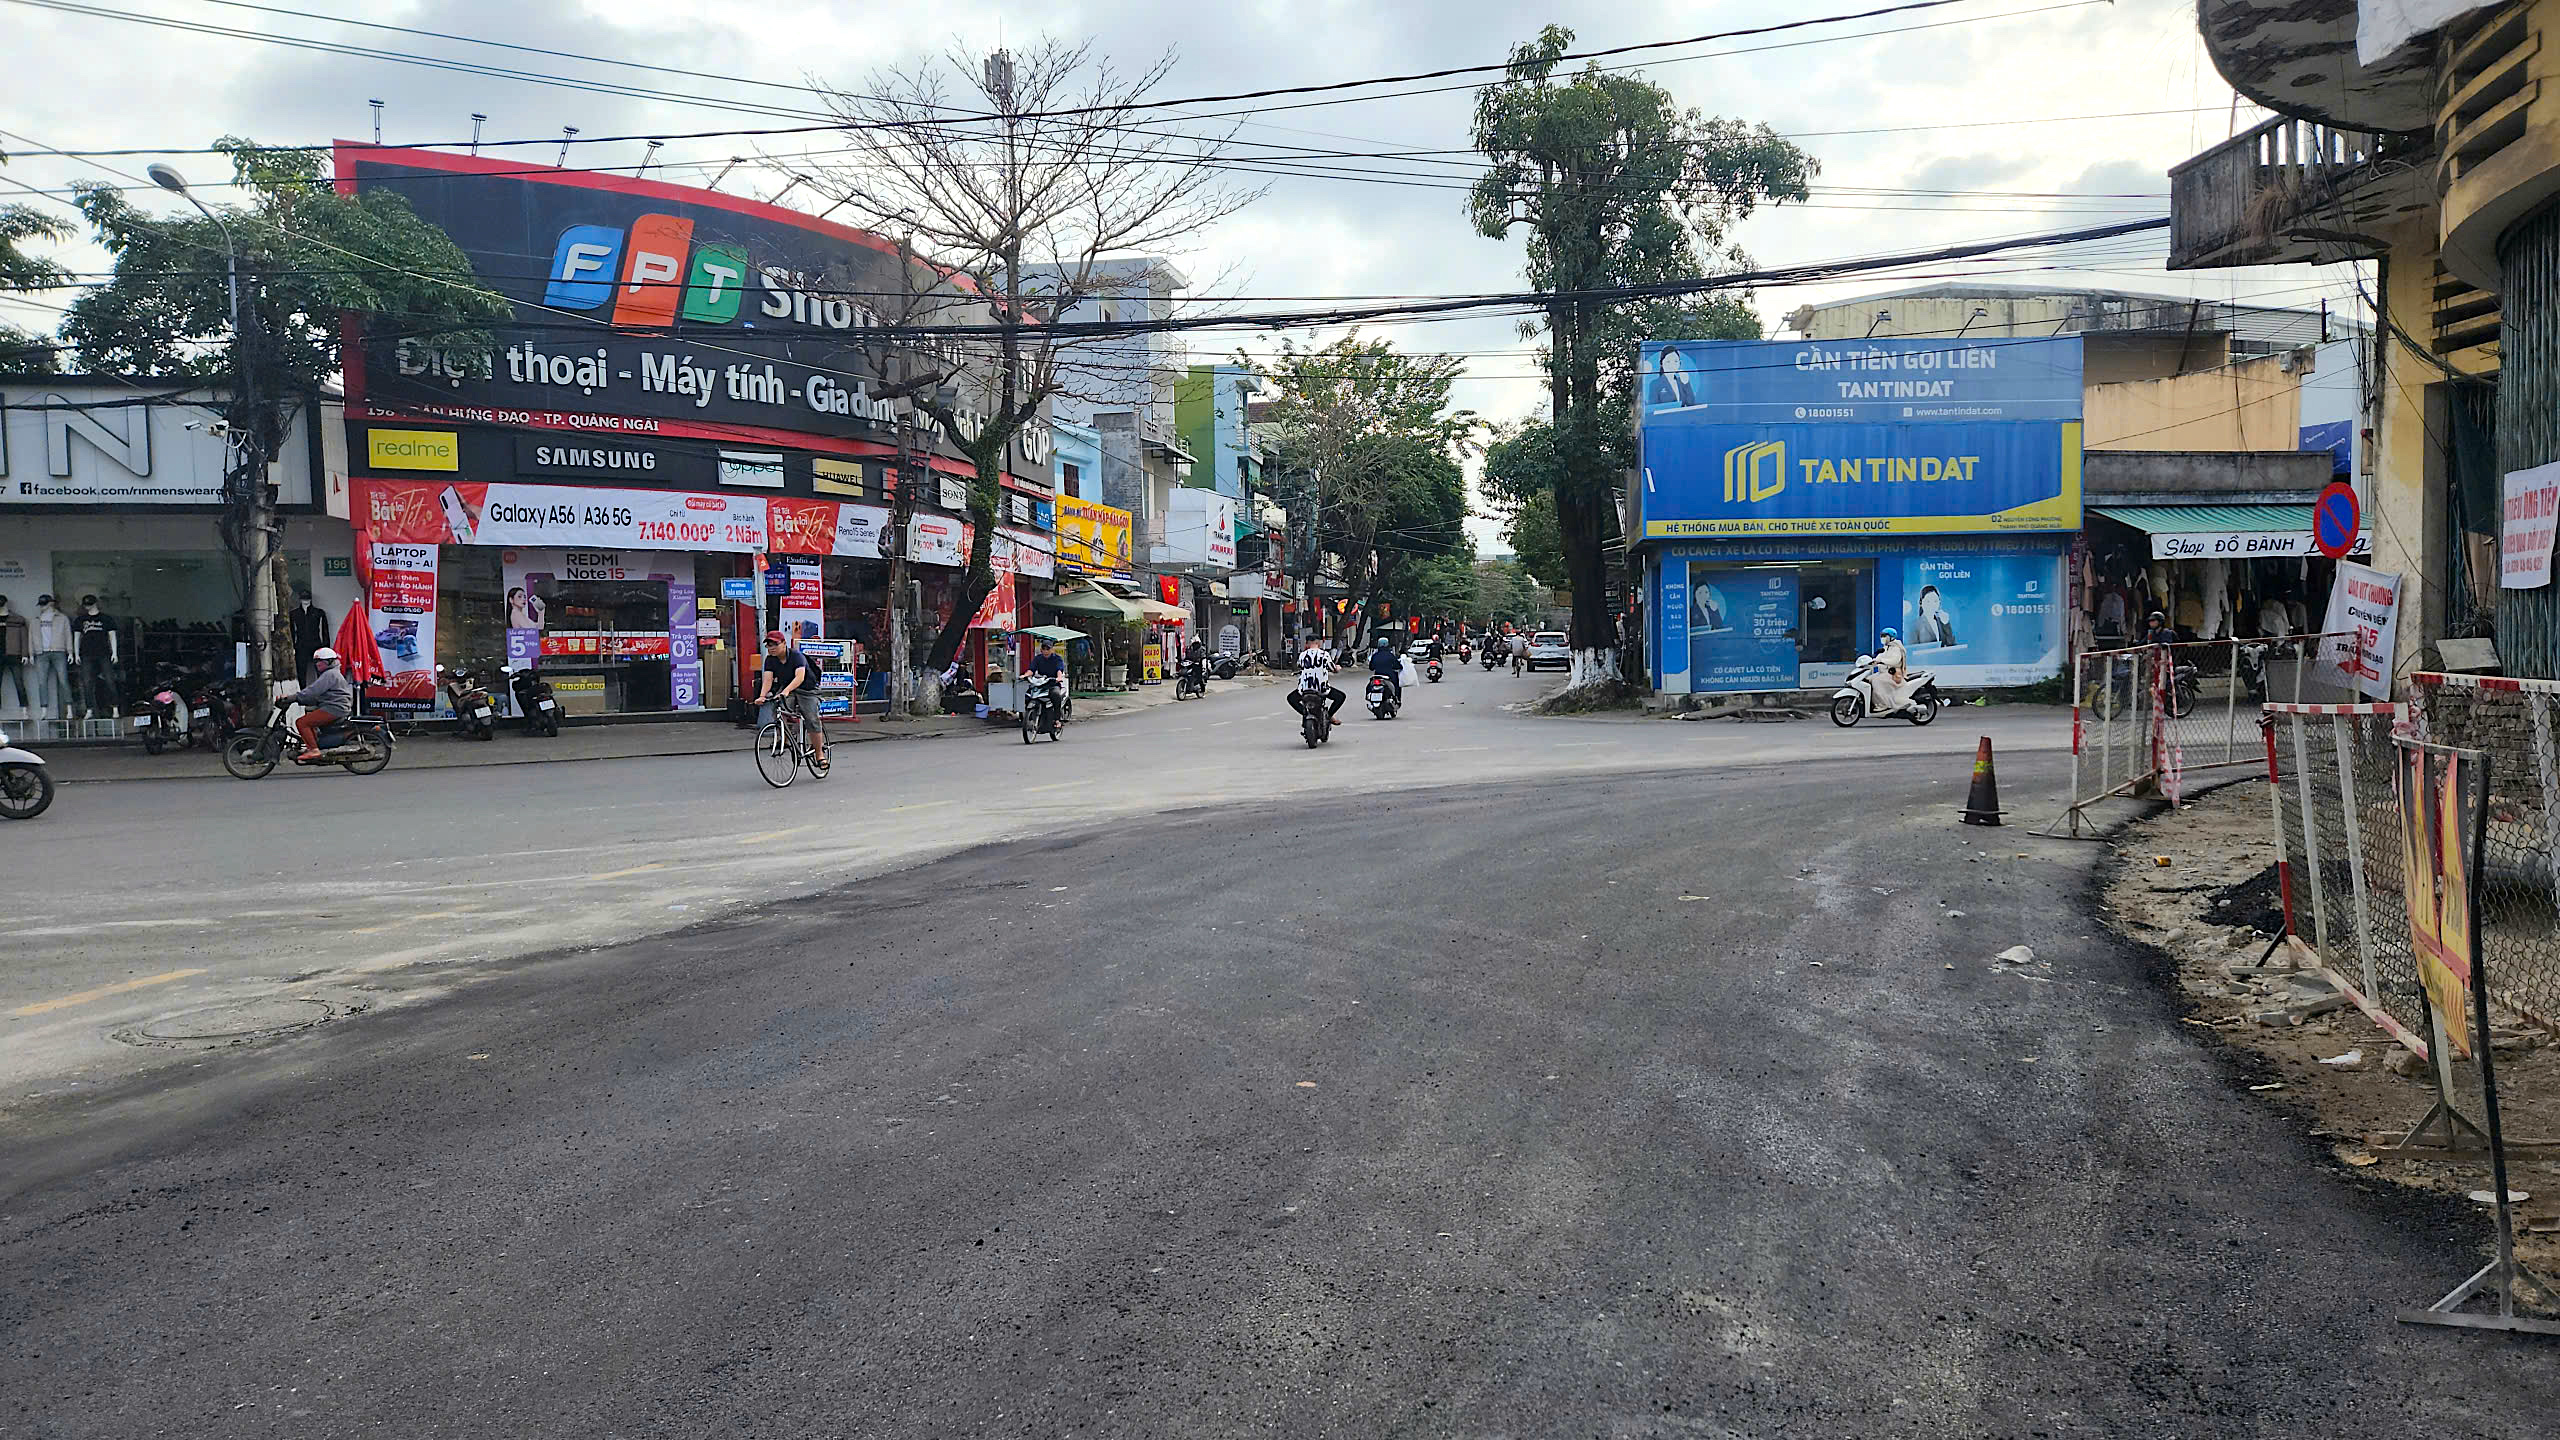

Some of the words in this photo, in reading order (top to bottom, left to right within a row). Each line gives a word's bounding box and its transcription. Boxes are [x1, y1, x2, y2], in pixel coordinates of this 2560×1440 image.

[562, 243, 738, 304] FPT
[1795, 344, 1842, 371] CẦN
[1846, 344, 1897, 371] TIỀN
[1903, 350, 1941, 375] GỌI
[1947, 343, 1996, 369] LIỀN
[507, 340, 608, 396] thoại
[641, 352, 717, 408] Máy
[724, 362, 785, 406] tính
[806, 375, 849, 415] Gia
[1808, 408, 1854, 417] 18001551
[1916, 406, 2002, 416] www.tantindat.com
[498, 410, 529, 424] ĐẠO
[544, 413, 565, 425] TP.
[568, 412, 620, 429] QUẢNG
[623, 416, 660, 431] NGÃI
[376, 439, 450, 458] realme
[536, 446, 656, 470] SAMSUNG
[942, 488, 964, 501] SONY
[490, 502, 546, 529] Galaxy
[549, 505, 576, 525] A56
[583, 507, 610, 526] A36
[612, 508, 633, 527] 5G
[1992, 515, 2002, 523] 02
[1666, 523, 1680, 535] HỆ
[1682, 522, 1716, 533] THỐNG
[1718, 523, 1741, 532] MUA
[1768, 522, 1789, 531] CHO
[1791, 520, 1816, 531] THUÊ
[1819, 521, 1832, 530] XE
[1834, 520, 1861, 530] TOÀN
[1863, 519, 1891, 532] QUỐC
[725, 524, 734, 542] 2
[735, 525, 763, 544] Năm
[2164, 538, 2205, 556] Shop
[2215, 534, 2239, 552] ĐỒ
[381, 547, 427, 558] LAPTOP
[327, 559, 348, 569] 196
[374, 557, 413, 568] Gaming
[566, 553, 619, 566] REDMI
[1919, 561, 1936, 571] CẦN
[1937, 561, 1955, 570] TIỀN
[566, 568, 607, 579] Note
[607, 567, 625, 579] 15
[1938, 571, 1953, 580] GỌI
[1953, 569, 1971, 579] LIỀN
[790, 582, 807, 591] .49
[2006, 604, 2056, 615] 18001551
[1753, 618, 1765, 627] 30
[510, 635, 526, 657] 5
[678, 688, 687, 699] 2
